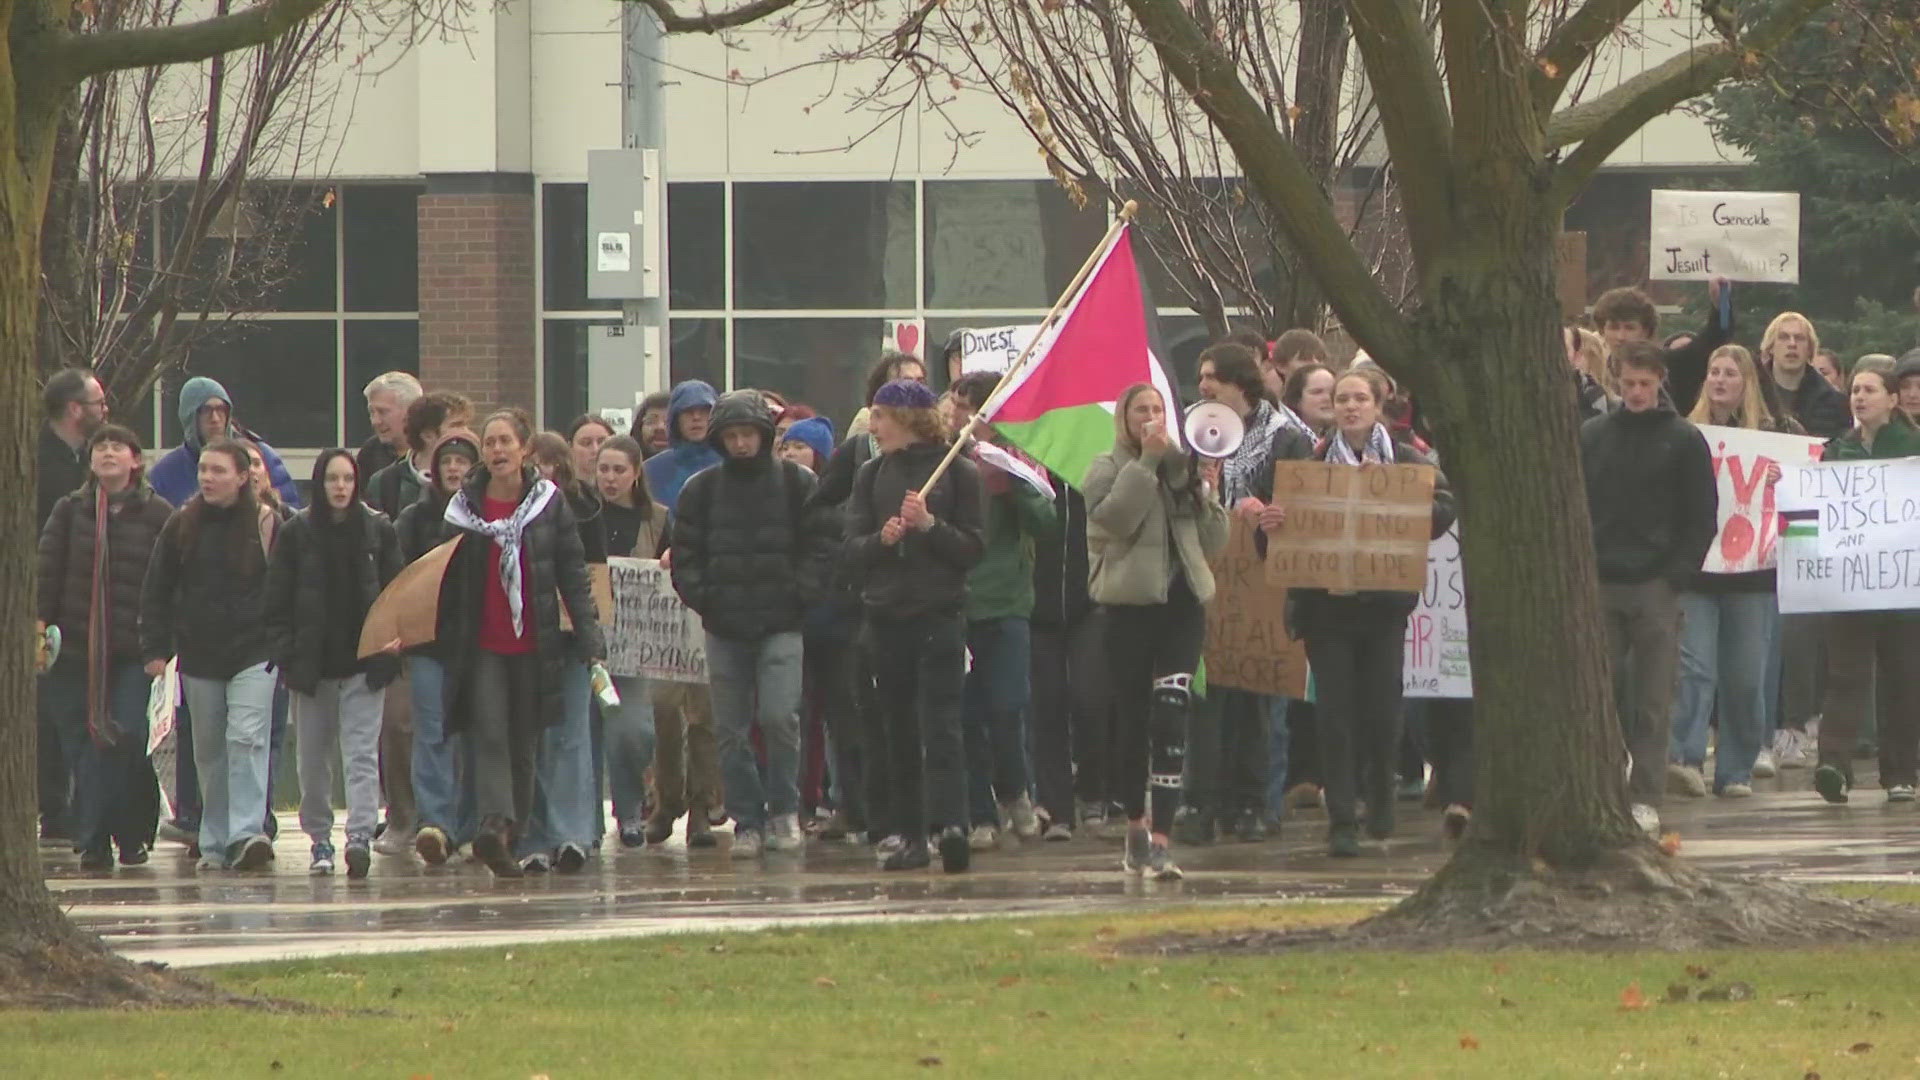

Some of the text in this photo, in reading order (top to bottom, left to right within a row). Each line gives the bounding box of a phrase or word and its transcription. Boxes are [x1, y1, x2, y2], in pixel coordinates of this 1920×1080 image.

[1712, 202, 1771, 227] Genocide
[963, 331, 1014, 355] DIVEST
[1291, 466, 1418, 498] STOP
[1799, 464, 1891, 499] DIVEST
[1289, 511, 1410, 536] UNDING
[1835, 534, 1866, 549] AND
[1274, 550, 1411, 578] GENOCIDE
[1796, 557, 1834, 581] FREE
[640, 641, 705, 673] DYING
